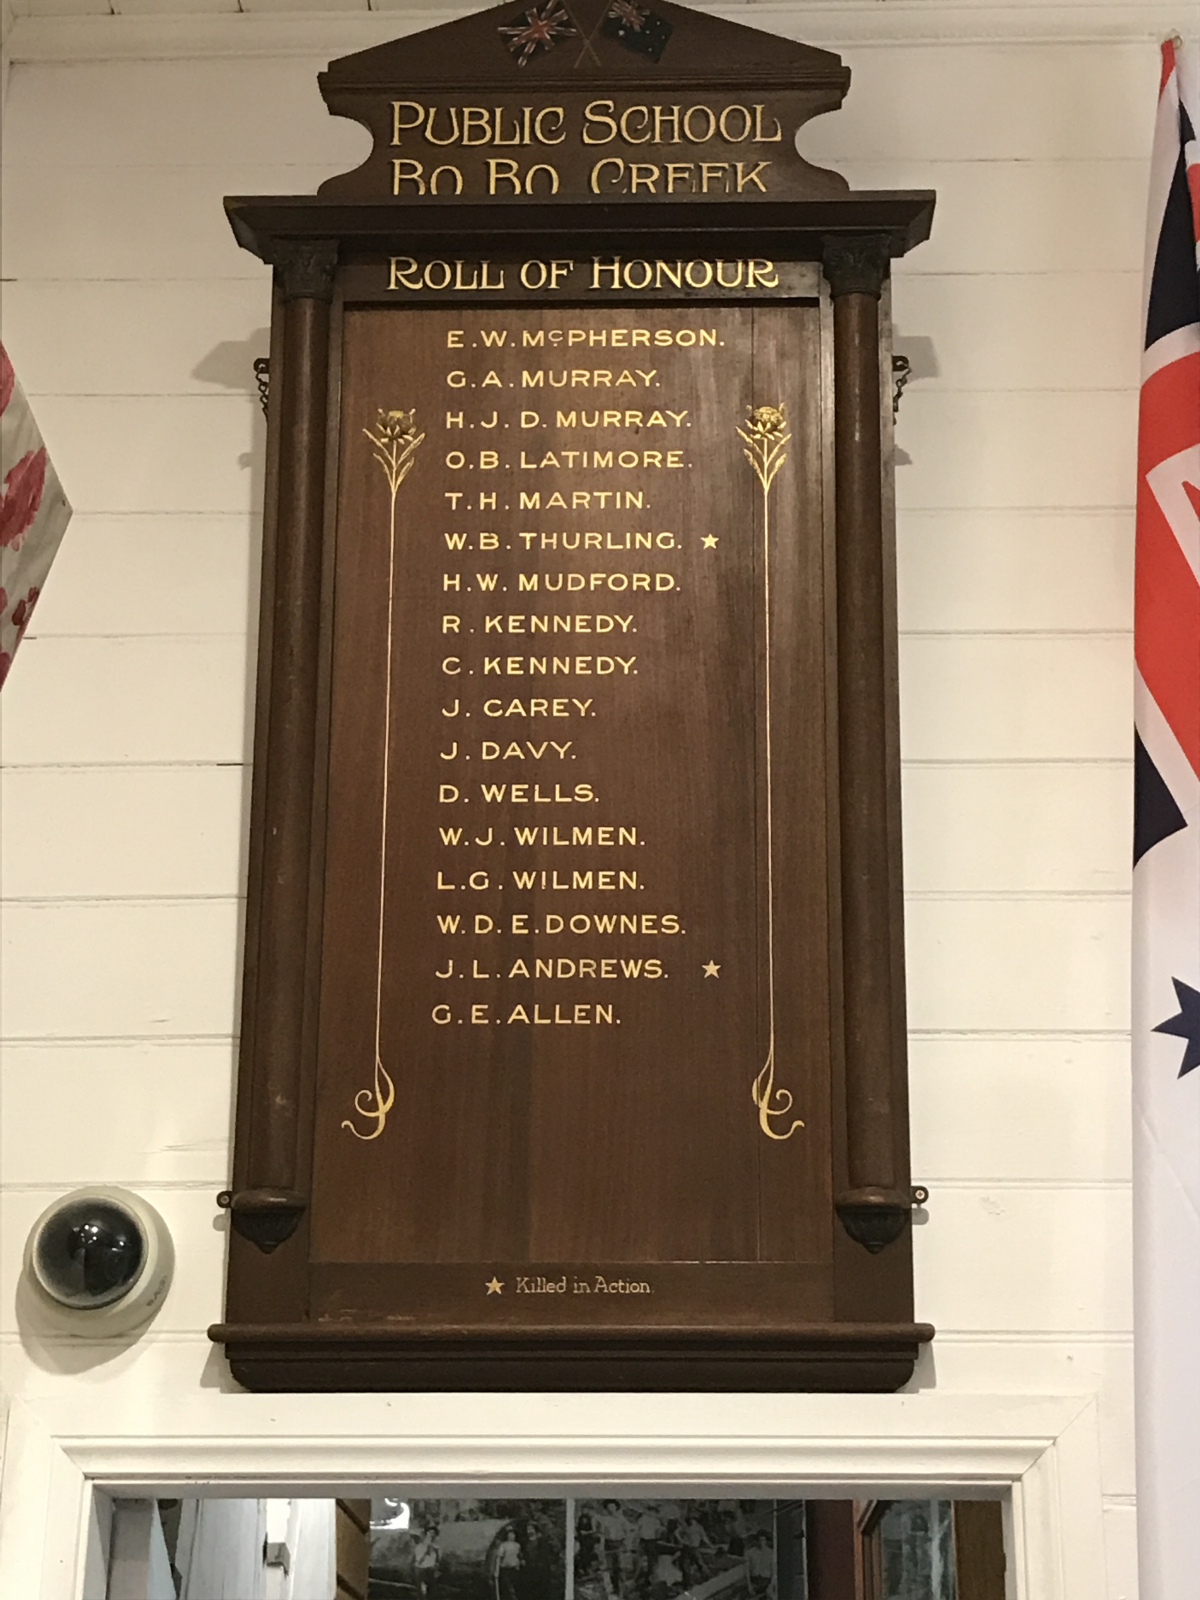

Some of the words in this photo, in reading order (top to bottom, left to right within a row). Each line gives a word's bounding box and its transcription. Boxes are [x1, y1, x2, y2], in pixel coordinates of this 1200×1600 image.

[391, 101, 566, 145] PUBLIC
[583, 100, 782, 143] SCHOOL
[387, 256, 505, 290] ROLL
[520, 259, 573, 289] OF
[589, 256, 779, 289] HONOUR
[521, 370, 661, 388] MURRAY.
[556, 411, 692, 428] MURRAY.
[520, 451, 693, 469] LATIMORE.
[519, 492, 651, 510] MARTIN.
[519, 532, 683, 550] THURLING.
[518, 573, 681, 591] MUDFORD.
[485, 615, 638, 633] KENNEDY.
[484, 656, 639, 675] KENNEDY.
[483, 698, 597, 717] CAREY.
[481, 741, 577, 760] DAVY.
[480, 784, 600, 803] WELLS.
[514, 827, 646, 846] WILMEN.
[512, 871, 645, 890] WILMEN.
[515, 1276, 567, 1294] Killed
[573, 1276, 591, 1294] in
